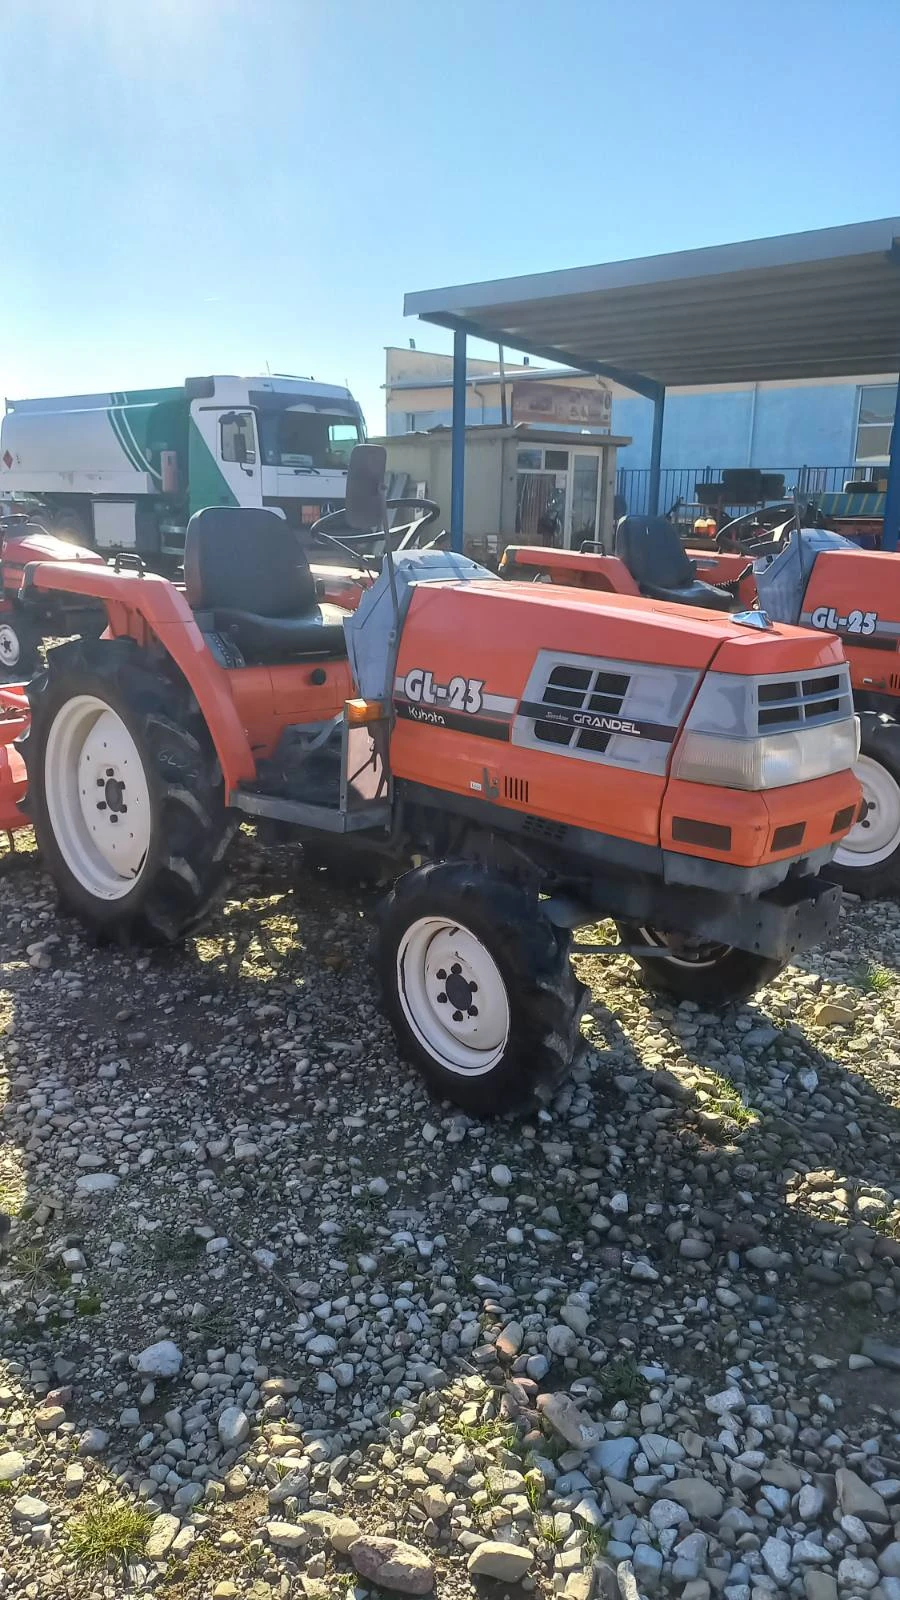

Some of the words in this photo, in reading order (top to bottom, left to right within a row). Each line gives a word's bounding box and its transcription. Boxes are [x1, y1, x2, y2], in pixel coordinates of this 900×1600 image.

[811, 606, 877, 635] GL-25
[404, 668, 484, 714] GL-23
[408, 705, 446, 725] Kubota
[572, 713, 641, 735] GRANDEL
